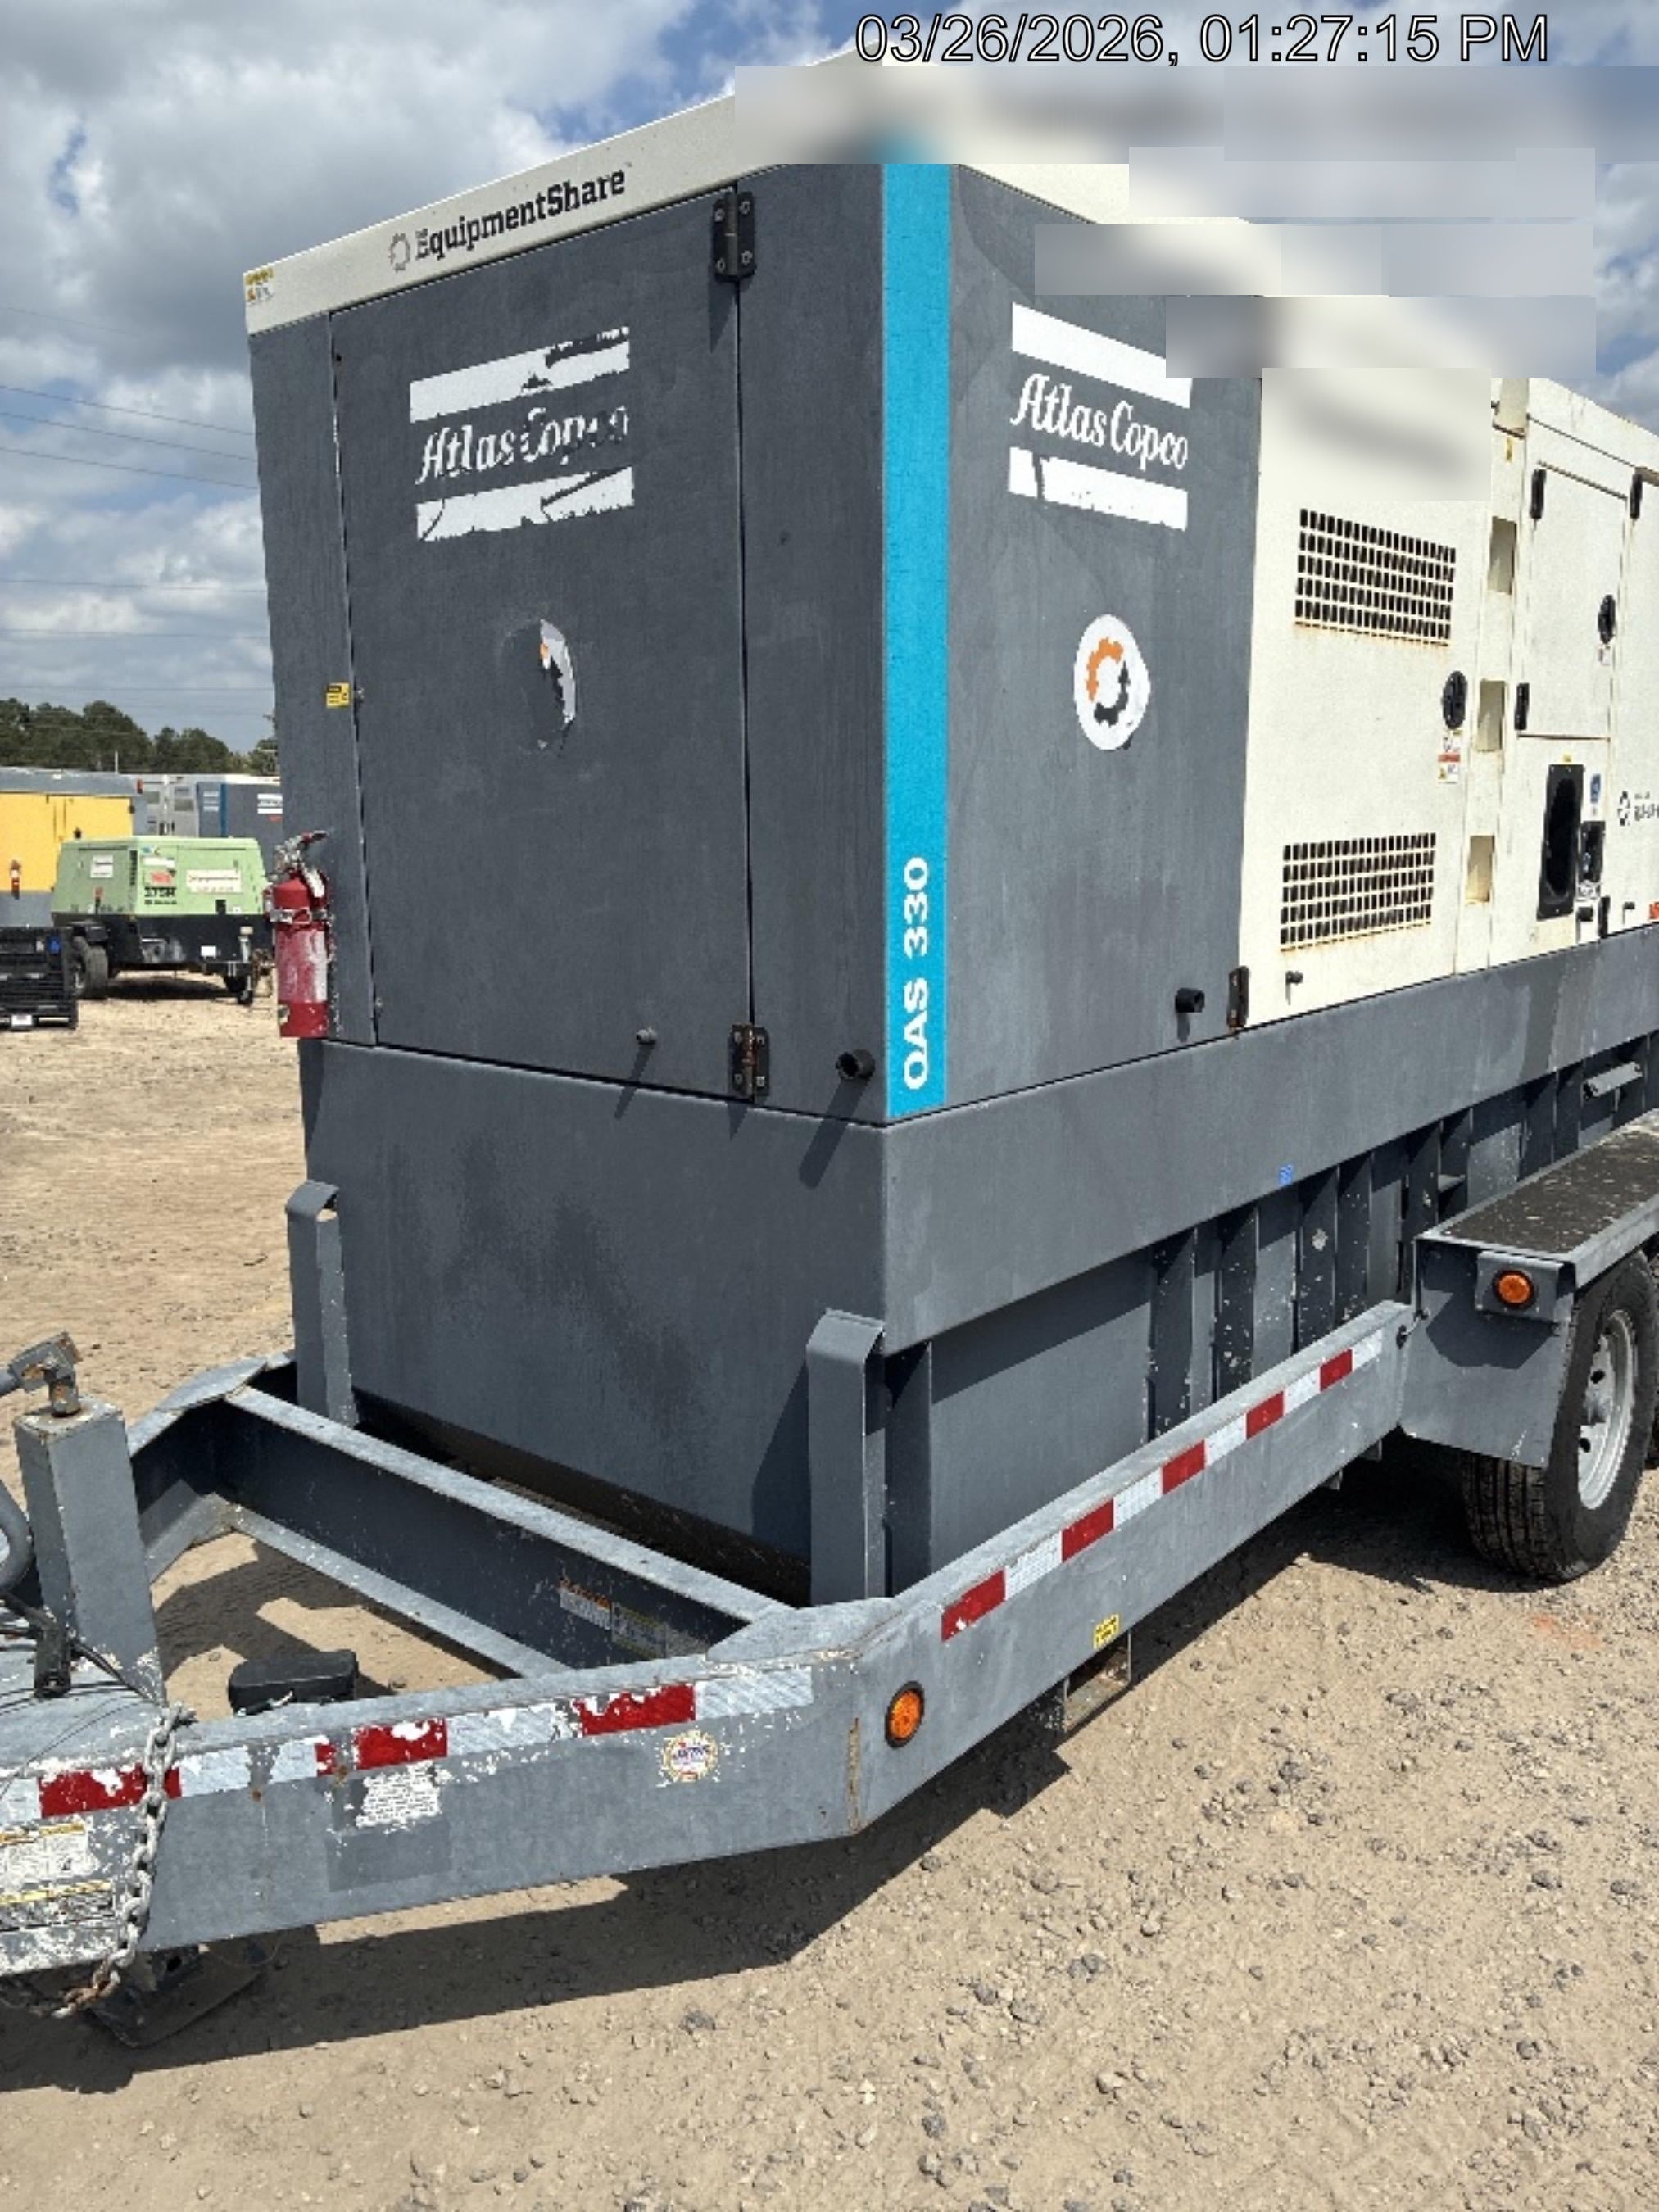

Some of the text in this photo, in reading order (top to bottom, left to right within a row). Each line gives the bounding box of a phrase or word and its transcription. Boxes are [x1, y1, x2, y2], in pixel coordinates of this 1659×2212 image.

[415, 170, 625, 261] EquipmentShare
[904, 857, 927, 1090] OAS 330
